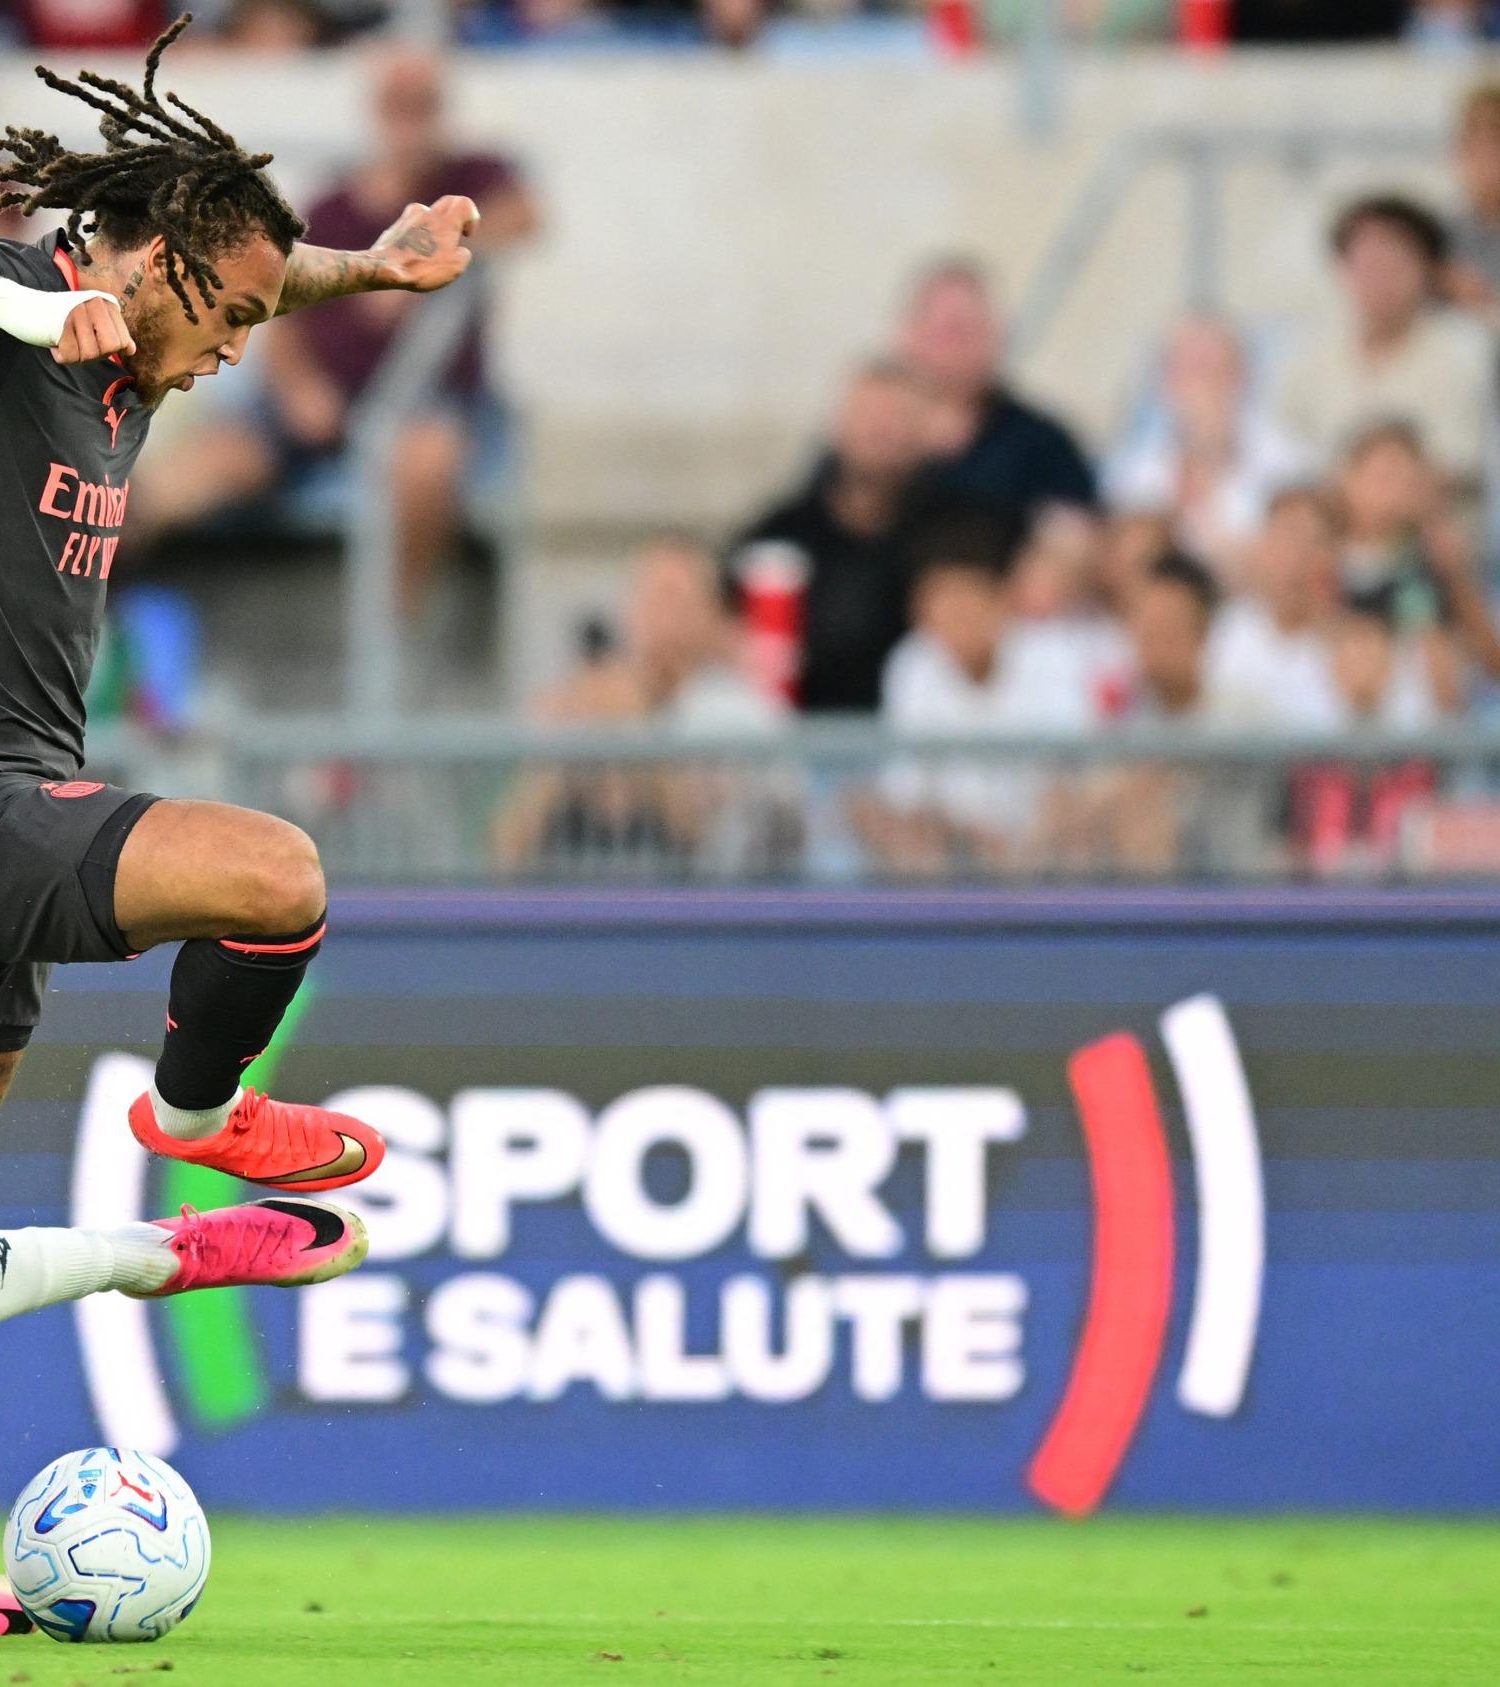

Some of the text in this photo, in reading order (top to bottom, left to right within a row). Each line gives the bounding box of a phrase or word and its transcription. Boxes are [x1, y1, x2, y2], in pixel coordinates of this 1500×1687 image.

[57, 532, 101, 577] FLY
[312, 1085, 1025, 1260] SPORT
[298, 1271, 1025, 1402] E SALUTE
